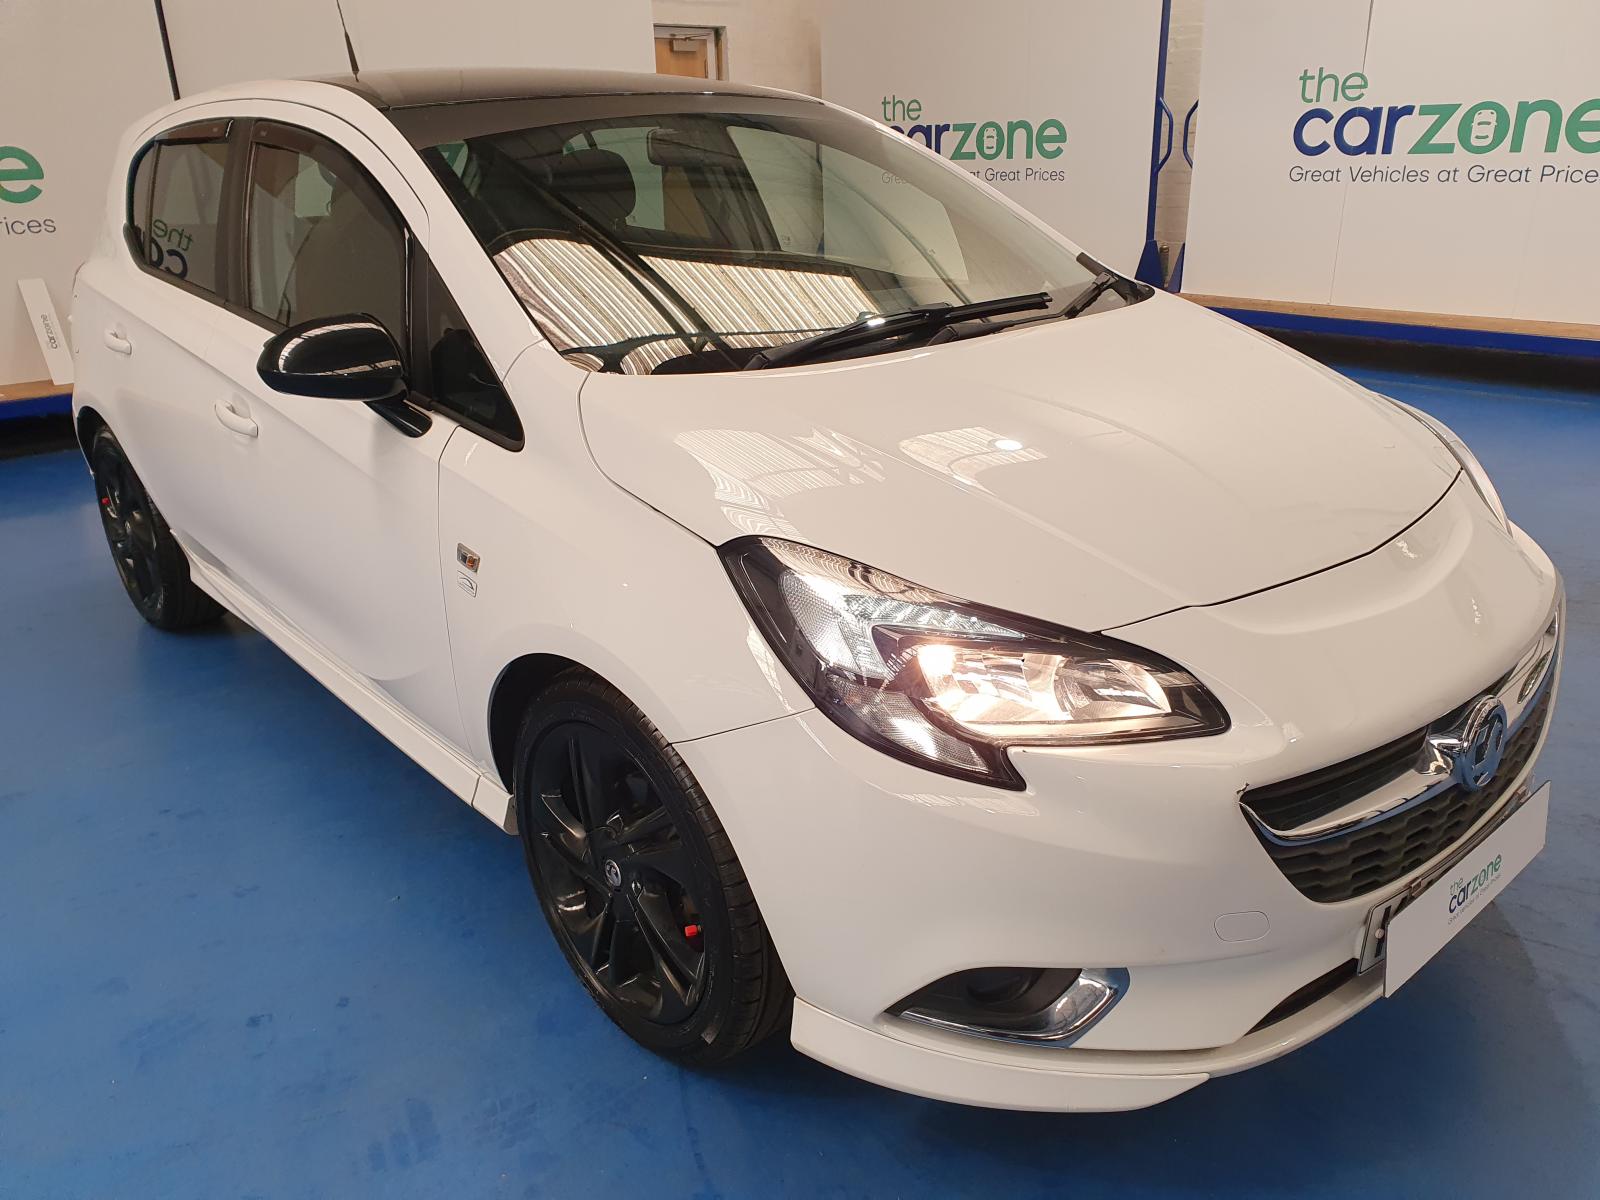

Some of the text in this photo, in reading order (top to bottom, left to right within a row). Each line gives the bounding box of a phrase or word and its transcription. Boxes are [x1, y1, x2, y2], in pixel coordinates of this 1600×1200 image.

[1299, 67, 1368, 103] the
[881, 94, 922, 121] the
[1293, 98, 1600, 157] carzone
[984, 167, 1021, 182] Great
[1025, 167, 1065, 182] Prices
[1289, 164, 1600, 183] Great Vehicles at Great Price
[0, 216, 57, 235] ices
[1449, 854, 1502, 914] carzone
